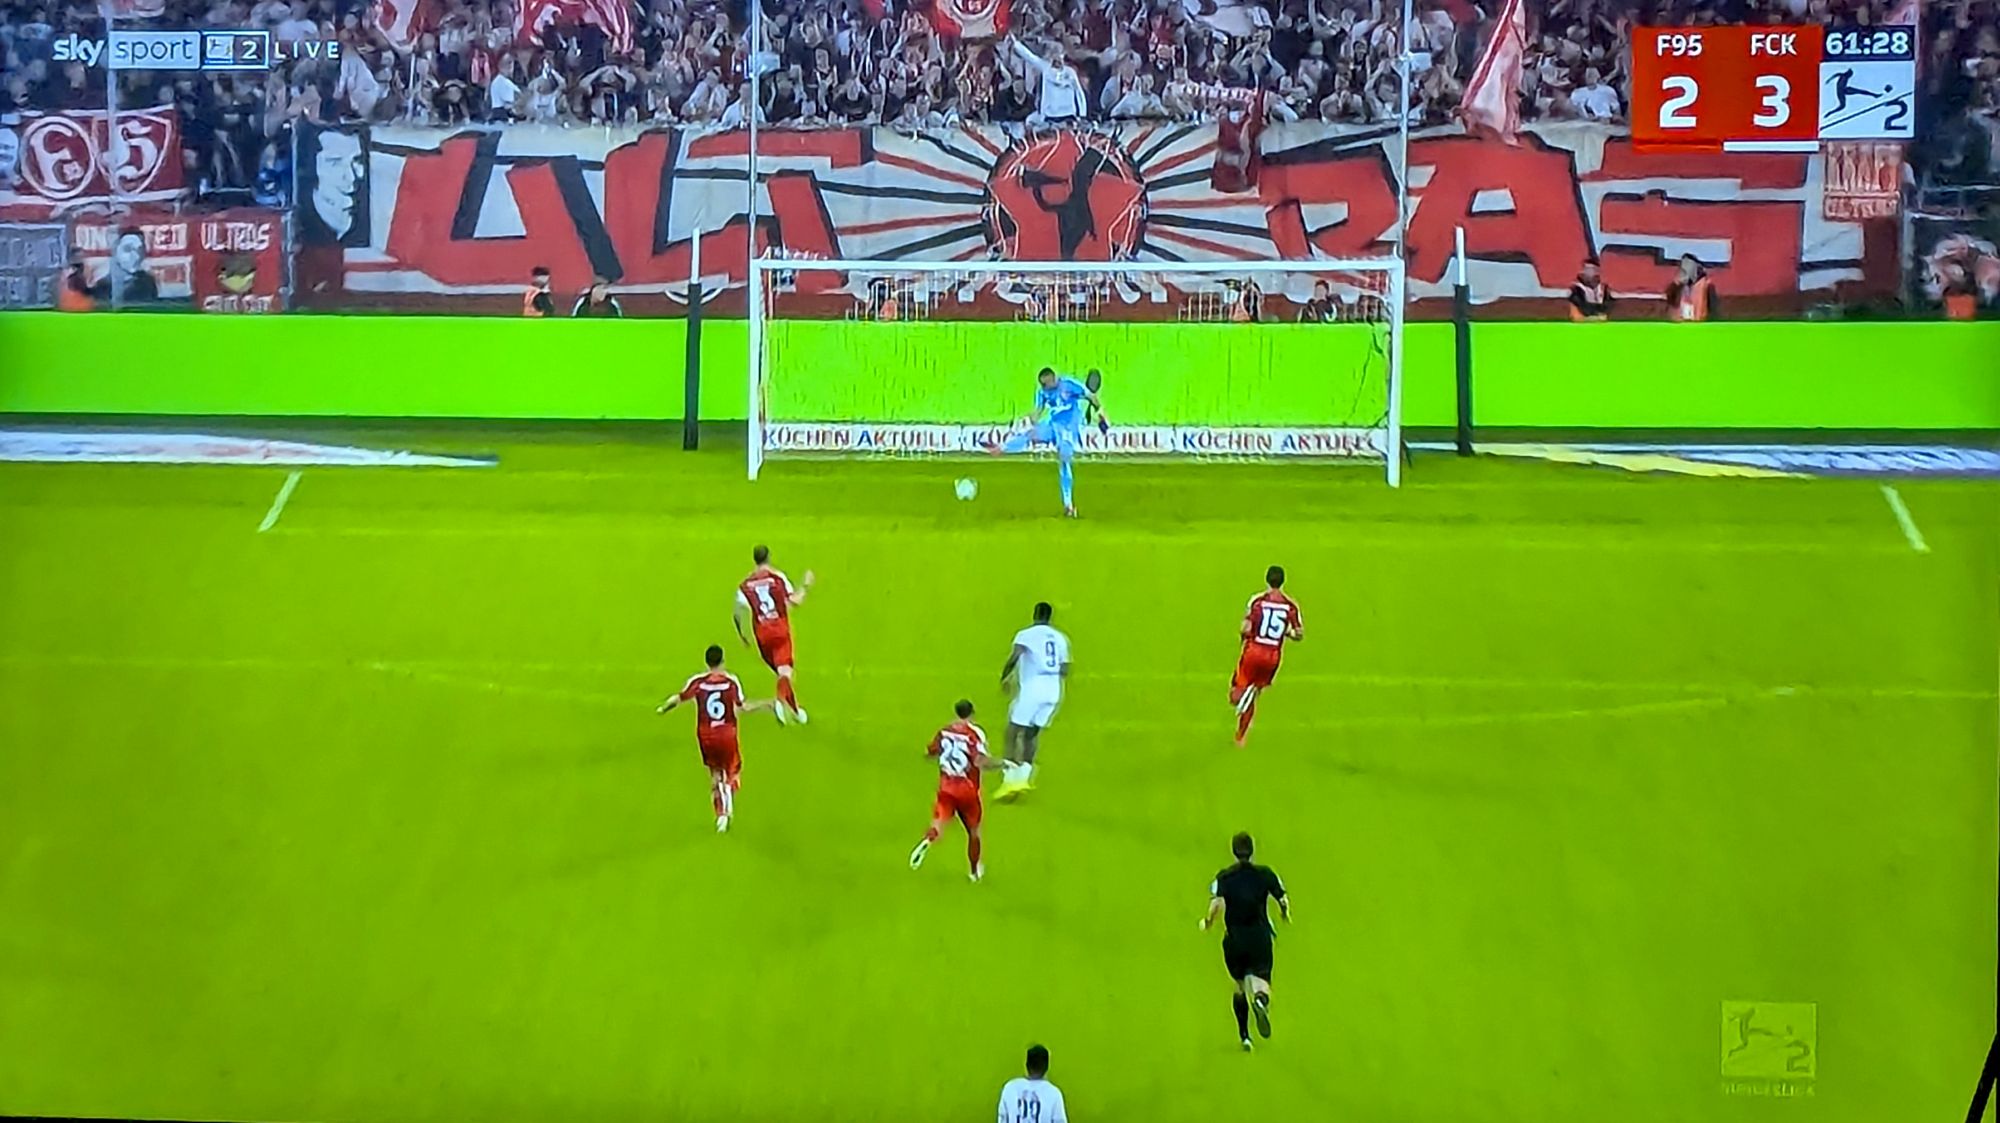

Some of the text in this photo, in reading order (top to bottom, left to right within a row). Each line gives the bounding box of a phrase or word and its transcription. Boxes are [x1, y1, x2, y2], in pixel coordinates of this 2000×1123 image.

[52, 33, 339, 67] sky sport 2 LIVE
[1657, 33, 1797, 57] F95 FCK
[1825, 32, 1909, 55] 61:28
[1659, 75, 1791, 129] 2 3
[763, 426, 951, 448] KÜCHEN AKTUELL
[1182, 428, 1273, 451] KÜCHEN
[1260, 608, 1288, 639] 15
[1045, 640, 1056, 667] 9
[706, 692, 726, 719] 6
[939, 737, 969, 772] 25
